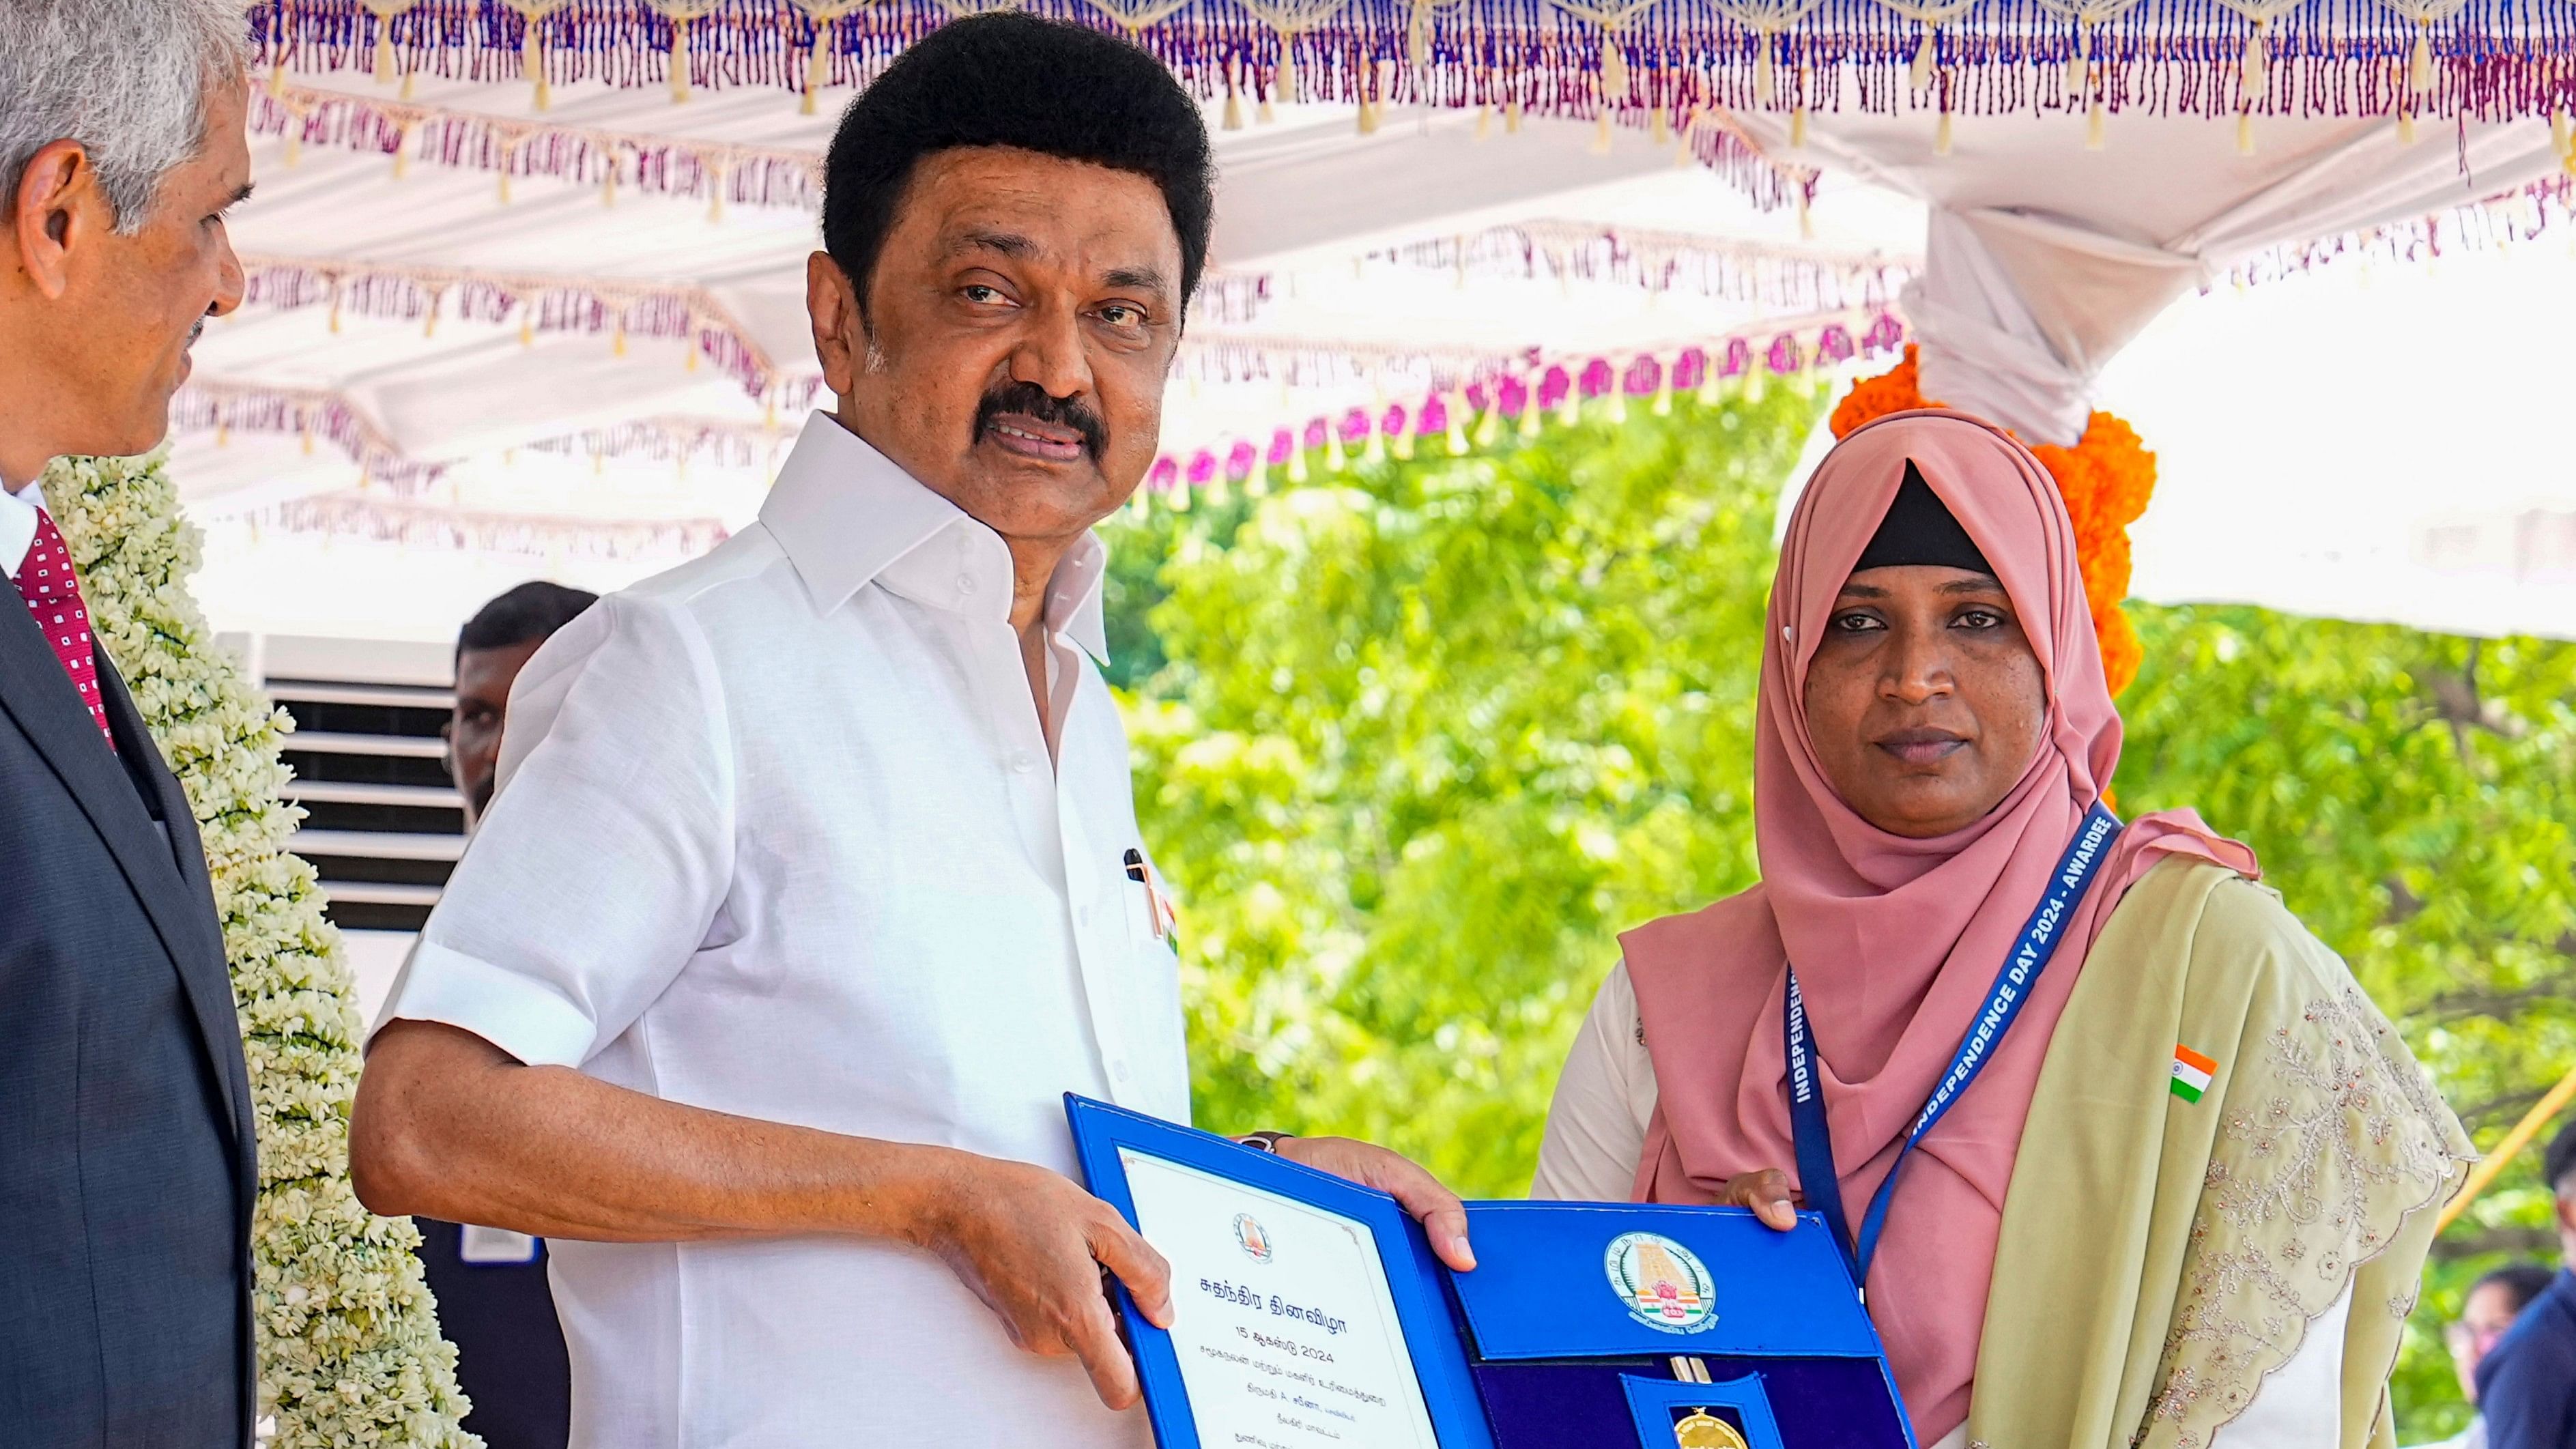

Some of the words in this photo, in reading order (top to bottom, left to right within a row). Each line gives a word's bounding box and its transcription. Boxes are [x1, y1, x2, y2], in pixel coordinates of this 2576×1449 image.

[2061, 816, 2112, 889] AWARDEE
[2061, 889, 2068, 898] -
[2031, 898, 2065, 945] 2024
[2008, 942, 2038, 986] DAY
[1790, 970, 1811, 1104] INDEPENDENC
[1913, 984, 2017, 1136] INDEPENDENCE
[1200, 1278, 1262, 1310] சுதந்திர
[1270, 1295, 1347, 1335] தினவிழா
[1235, 1326, 1249, 1338] 15
[1253, 1331, 1298, 1356] ஆகஸ்டு
[1300, 1345, 1334, 1364] 2024
[1253, 1359, 1283, 1375] மற்றும்
